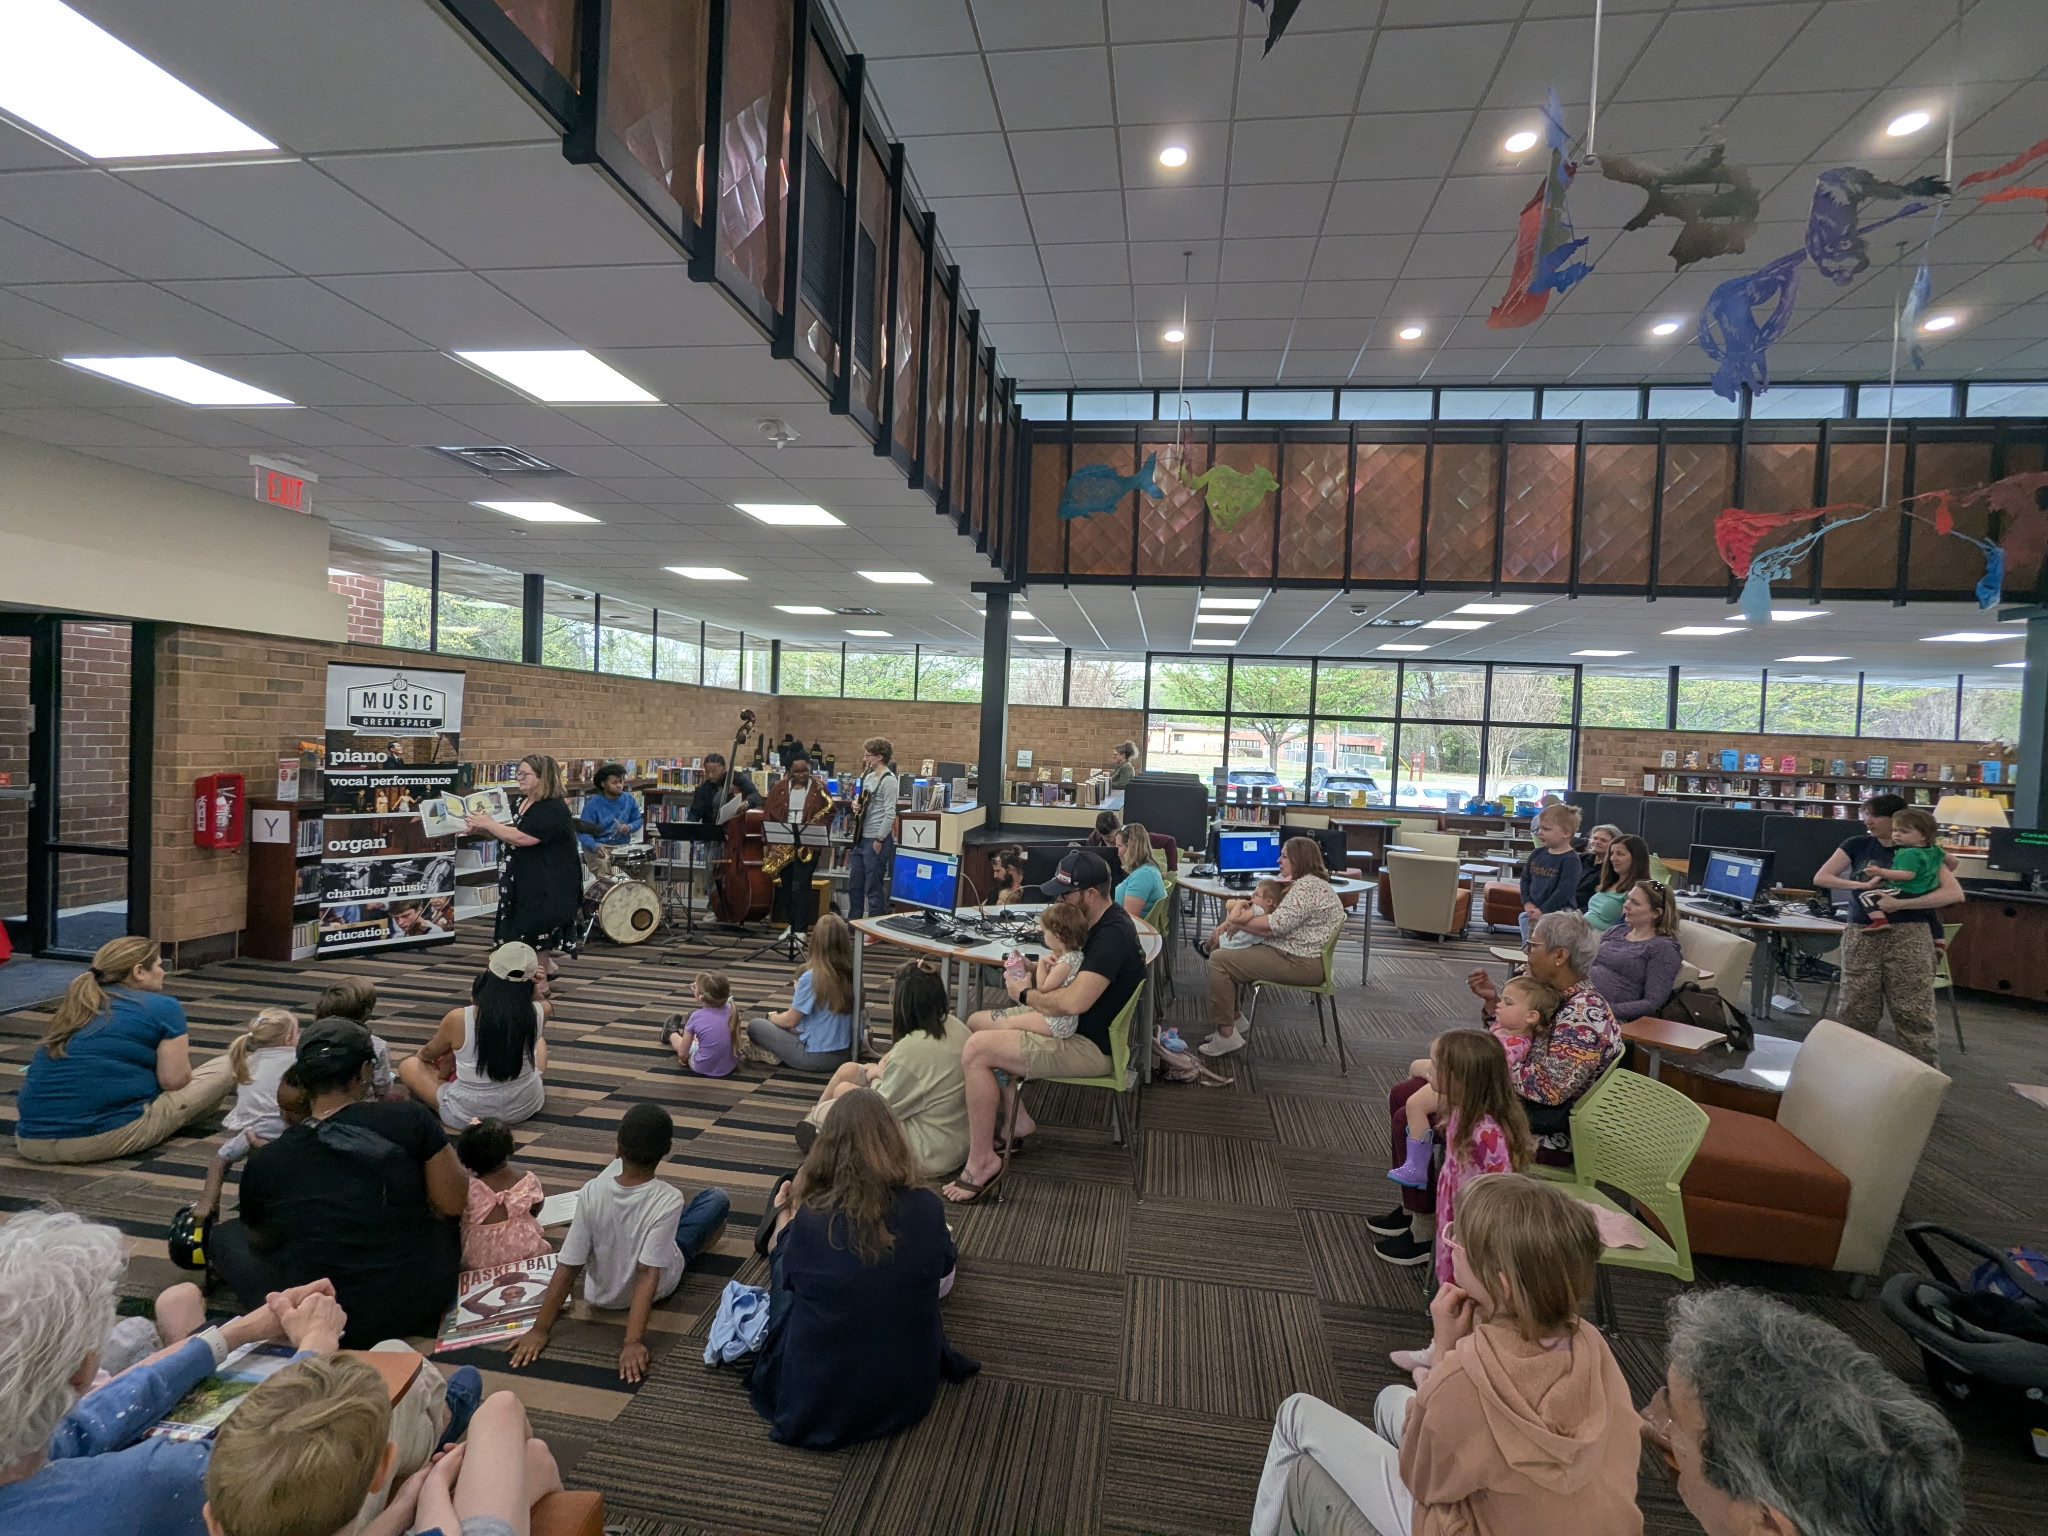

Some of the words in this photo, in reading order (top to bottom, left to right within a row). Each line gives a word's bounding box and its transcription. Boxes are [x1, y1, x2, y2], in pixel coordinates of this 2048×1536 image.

[267, 472, 304, 507] EXIT
[362, 691, 433, 711] MUSIC
[362, 718, 396, 726] GREAT
[399, 719, 432, 727] SPACE
[330, 748, 388, 765] piano
[329, 776, 369, 787] vocal
[369, 776, 452, 788] performance
[264, 817, 279, 837] Y
[912, 826, 926, 843] Y
[328, 837, 387, 853] organ
[326, 886, 388, 899] chamber
[389, 881, 428, 893] music
[325, 927, 390, 942] education
